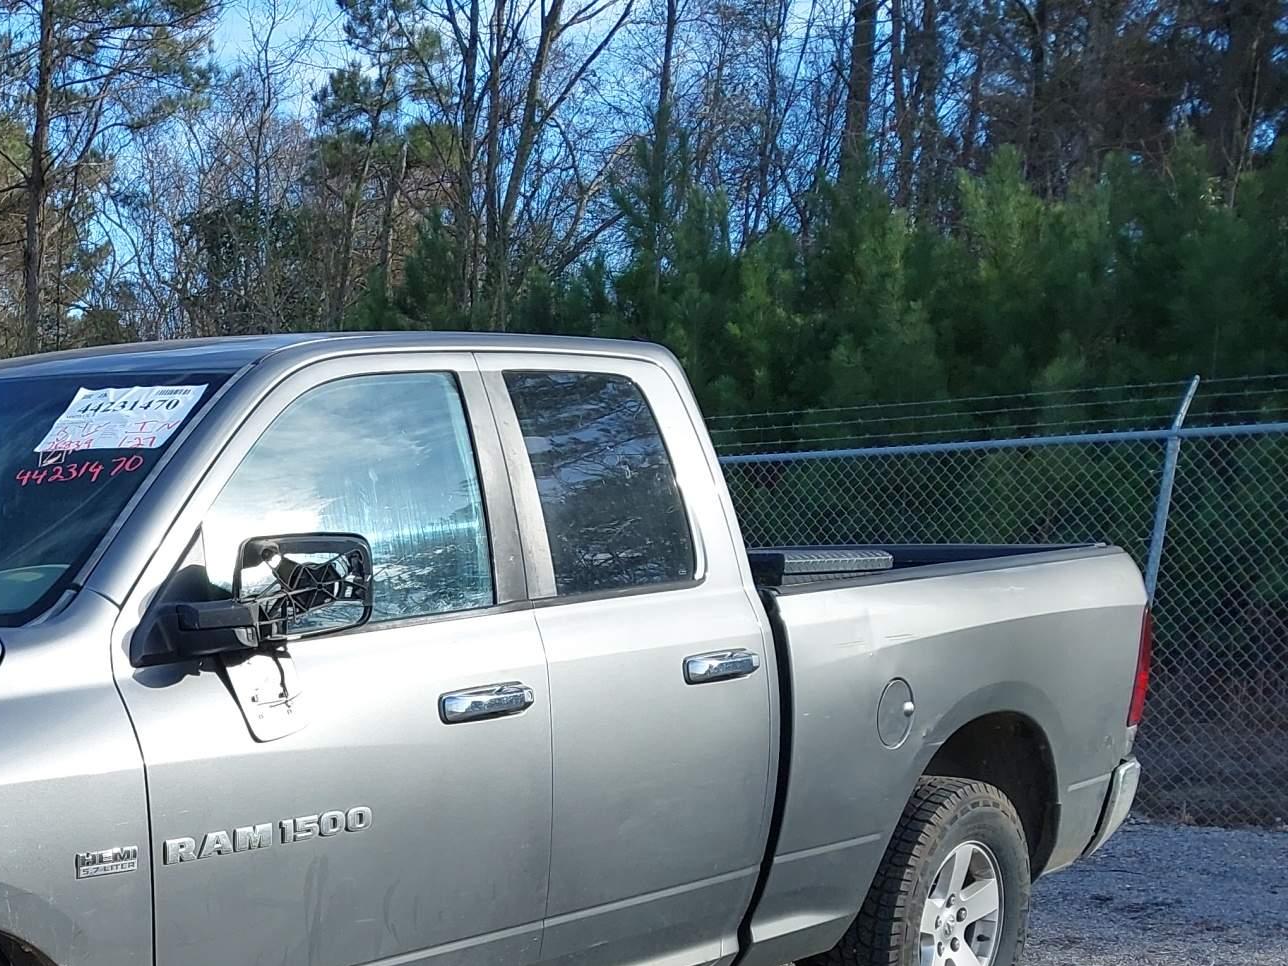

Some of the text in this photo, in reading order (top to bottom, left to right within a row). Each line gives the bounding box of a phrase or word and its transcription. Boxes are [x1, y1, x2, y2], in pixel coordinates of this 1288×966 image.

[77, 399, 181, 416] 44231470
[163, 806, 373, 866] RAM 1500
[78, 847, 138, 868] HEMI
[103, 860, 136, 873] LITER
